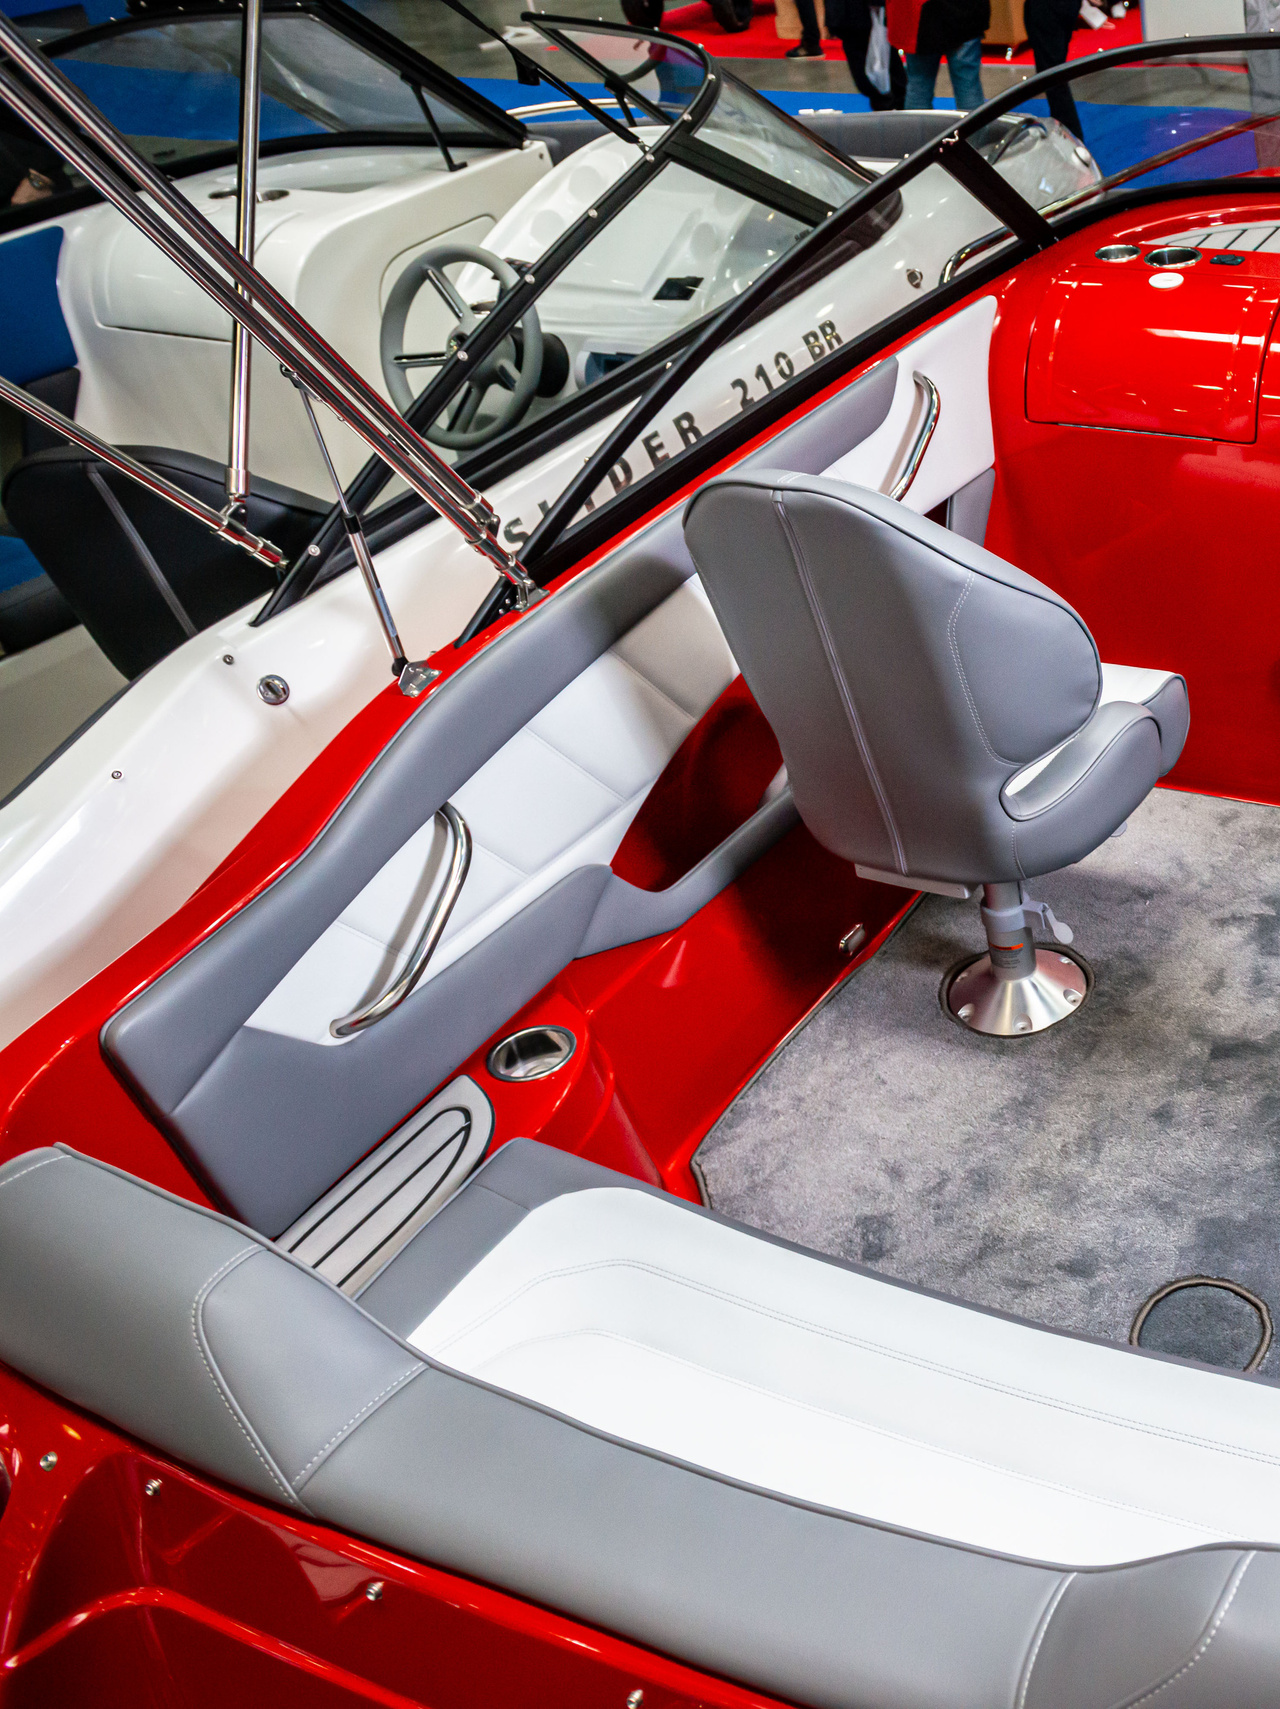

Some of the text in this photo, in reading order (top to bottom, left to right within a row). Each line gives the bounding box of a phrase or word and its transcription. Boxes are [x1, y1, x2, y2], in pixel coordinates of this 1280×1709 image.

[503, 319, 844, 556] SDER 210 BR
